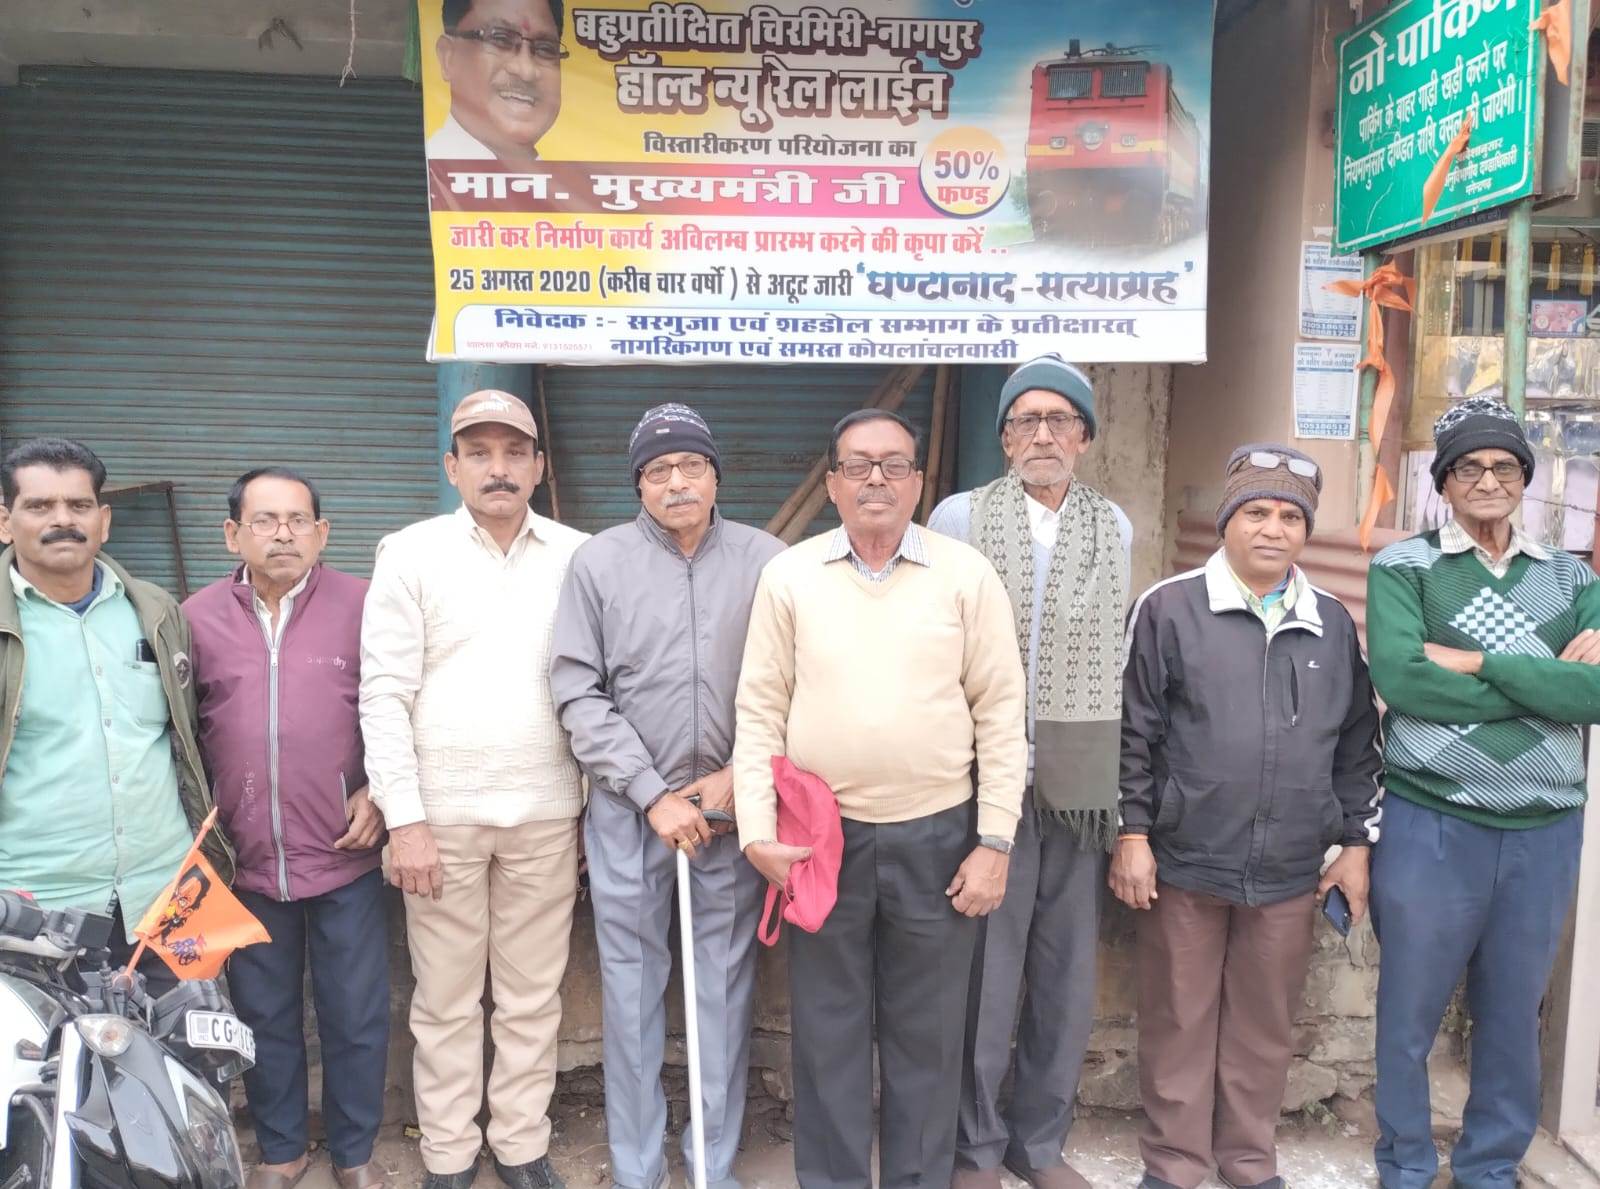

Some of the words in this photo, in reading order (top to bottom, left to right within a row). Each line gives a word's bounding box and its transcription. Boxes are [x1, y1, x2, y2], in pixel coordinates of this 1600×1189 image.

[572, 2, 746, 56] बहुप्रतीक्षित
[750, 5, 983, 68] चिरमिरी-नागपुर
[614, 52, 708, 116] हॉल्ट
[712, 65, 773, 132] न्यू
[763, 56, 836, 117] रेल
[838, 59, 953, 126] लाईन
[1396, 90, 1417, 122] बाहर
[1466, 40, 1490, 87] करने
[1492, 40, 1508, 73] पर
[644, 131, 771, 156] विस्तारीकरण
[779, 134, 882, 157] परियोजना
[889, 140, 917, 158] का
[934, 150, 999, 182] 50%
[447, 172, 570, 200] मान.
[590, 169, 818, 211] मुख्यमंत्री
[831, 172, 906, 205] जी
[937, 185, 991, 206] फण्ड
[450, 220, 495, 247] जारी
[500, 227, 530, 248] कर
[536, 221, 604, 249] निर्माण
[610, 222, 653, 250] कार्य
[661, 224, 748, 252] अविलम्ब
[754, 230, 813, 253] प्रारम्भ
[820, 227, 866, 253] करने
[871, 226, 899, 253] की
[903, 233, 948, 261] कृपा
[450, 269, 474, 290] 25
[481, 269, 534, 292] अगस्त
[540, 270, 591, 292] 2020
[599, 265, 651, 299] (करीब
[656, 272, 685, 295] चार
[746, 267, 762, 295] से
[767, 274, 810, 304] अटूट
[813, 269, 853, 296] जारी
[495, 309, 588, 329] निवेदक
[627, 315, 722, 336] सरगुजा
[728, 312, 770, 332] एवं
[776, 313, 873, 334] शहडोल
[880, 318, 970, 334] सम्भाग
[976, 314, 1004, 334] के
[610, 335, 733, 356] नागरिकगण
[739, 337, 772, 357] एवं
[779, 342, 842, 358] समस्त
[848, 338, 1019, 359] कोयलांचलवासी
